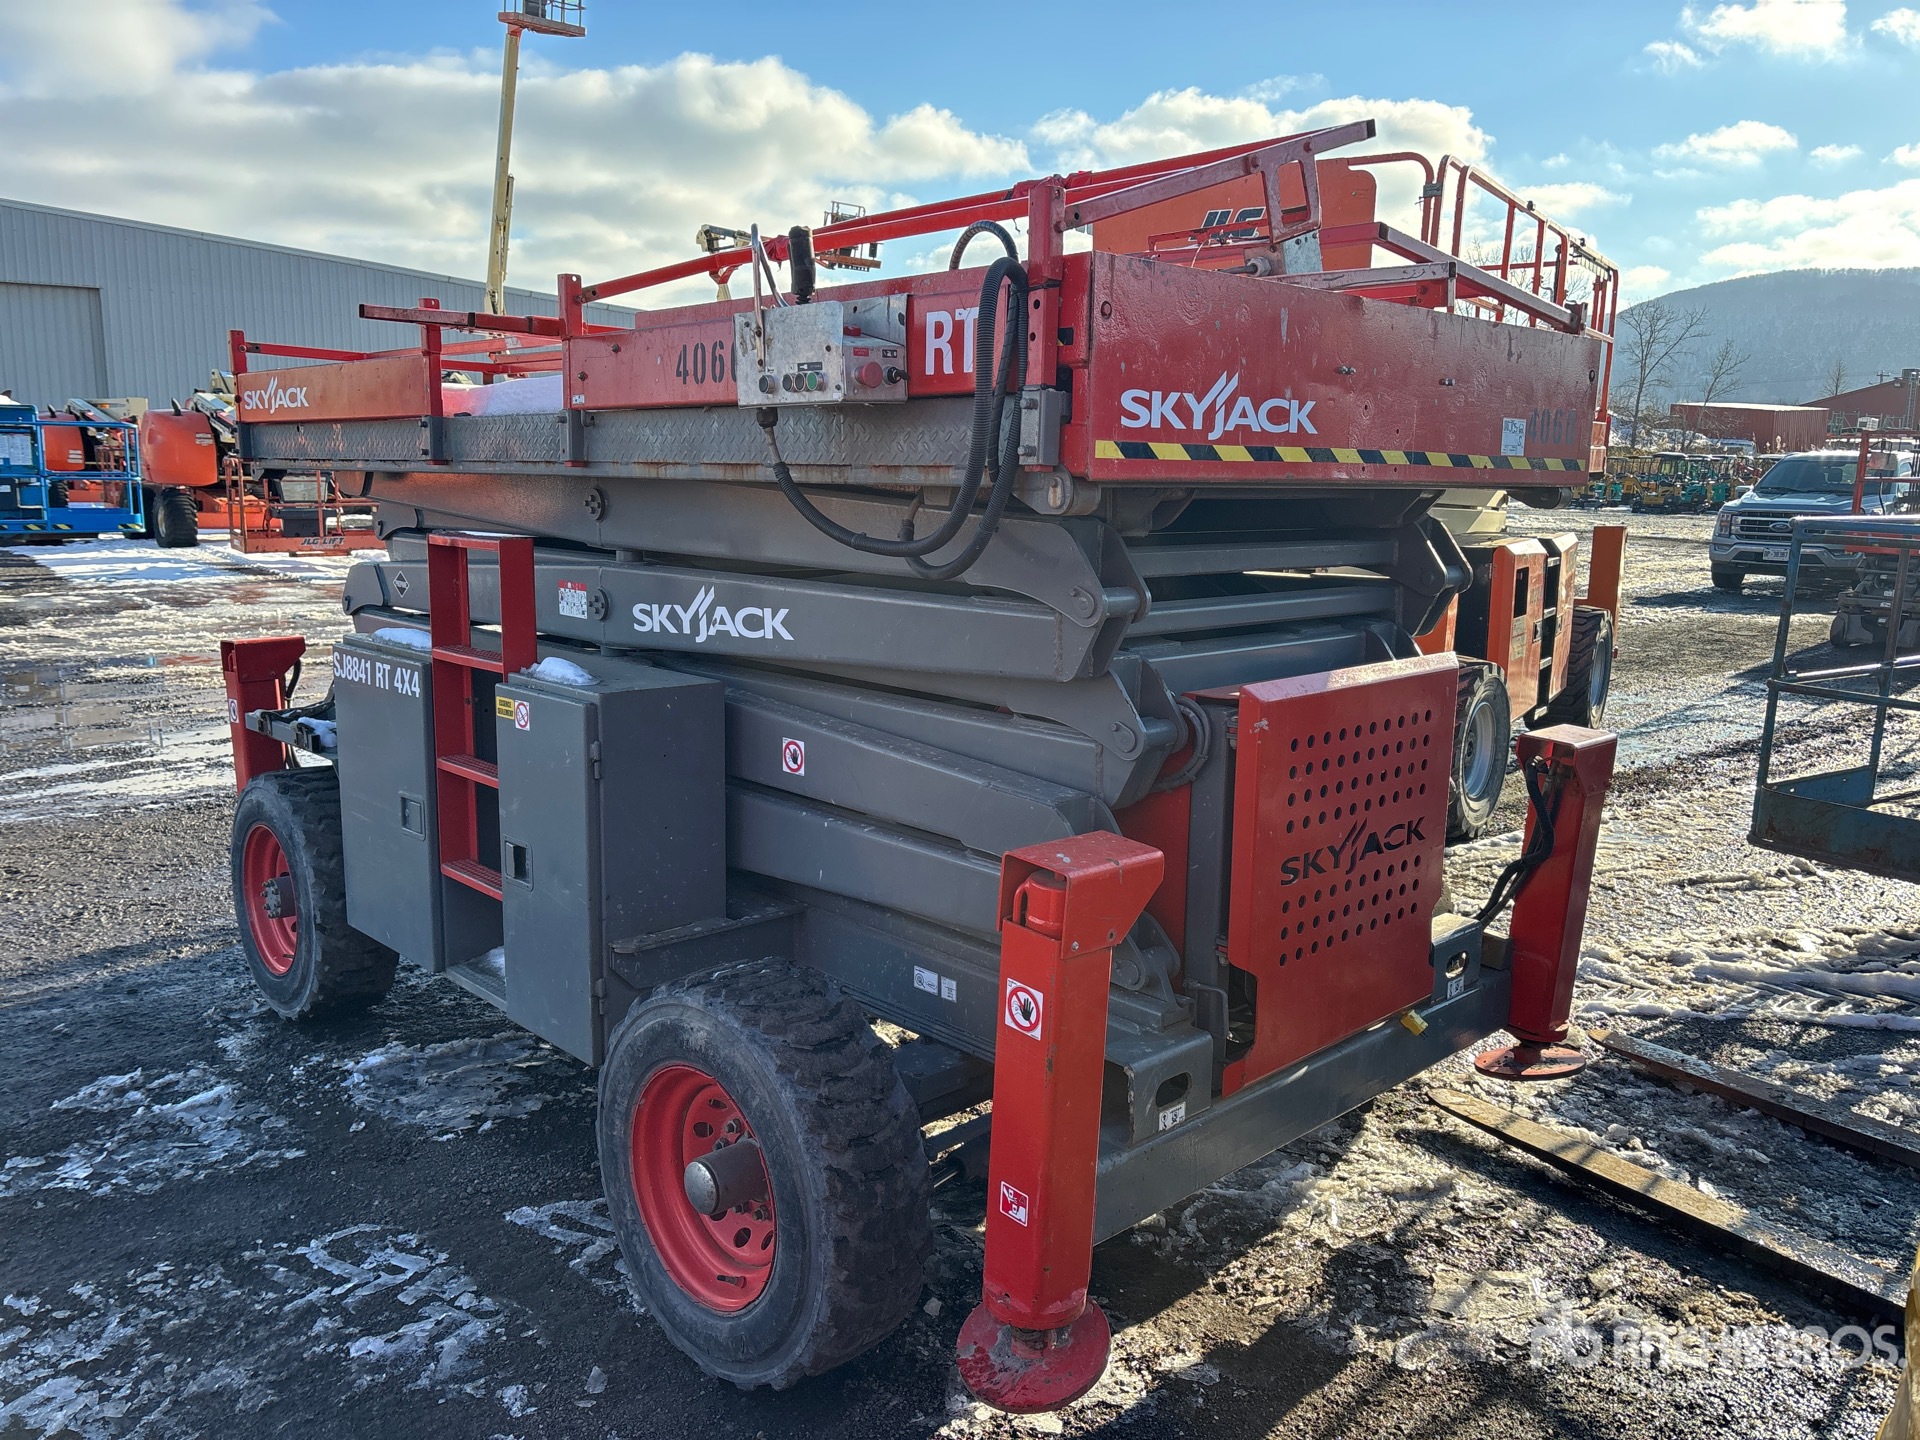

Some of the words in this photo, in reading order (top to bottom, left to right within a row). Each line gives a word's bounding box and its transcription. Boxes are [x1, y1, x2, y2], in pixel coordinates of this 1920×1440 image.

[925, 306, 980, 375] RT
[243, 375, 309, 414] SKYJACK
[1120, 370, 1319, 441] SKYJACK
[300, 537, 320, 546] JLG
[321, 536, 345, 545] LIFT
[632, 585, 795, 643] SKYJACK
[333, 651, 371, 685] SJ8841
[375, 661, 391, 690] RT
[394, 667, 420, 698] 4X4
[1280, 815, 1426, 886] SKYJACK
